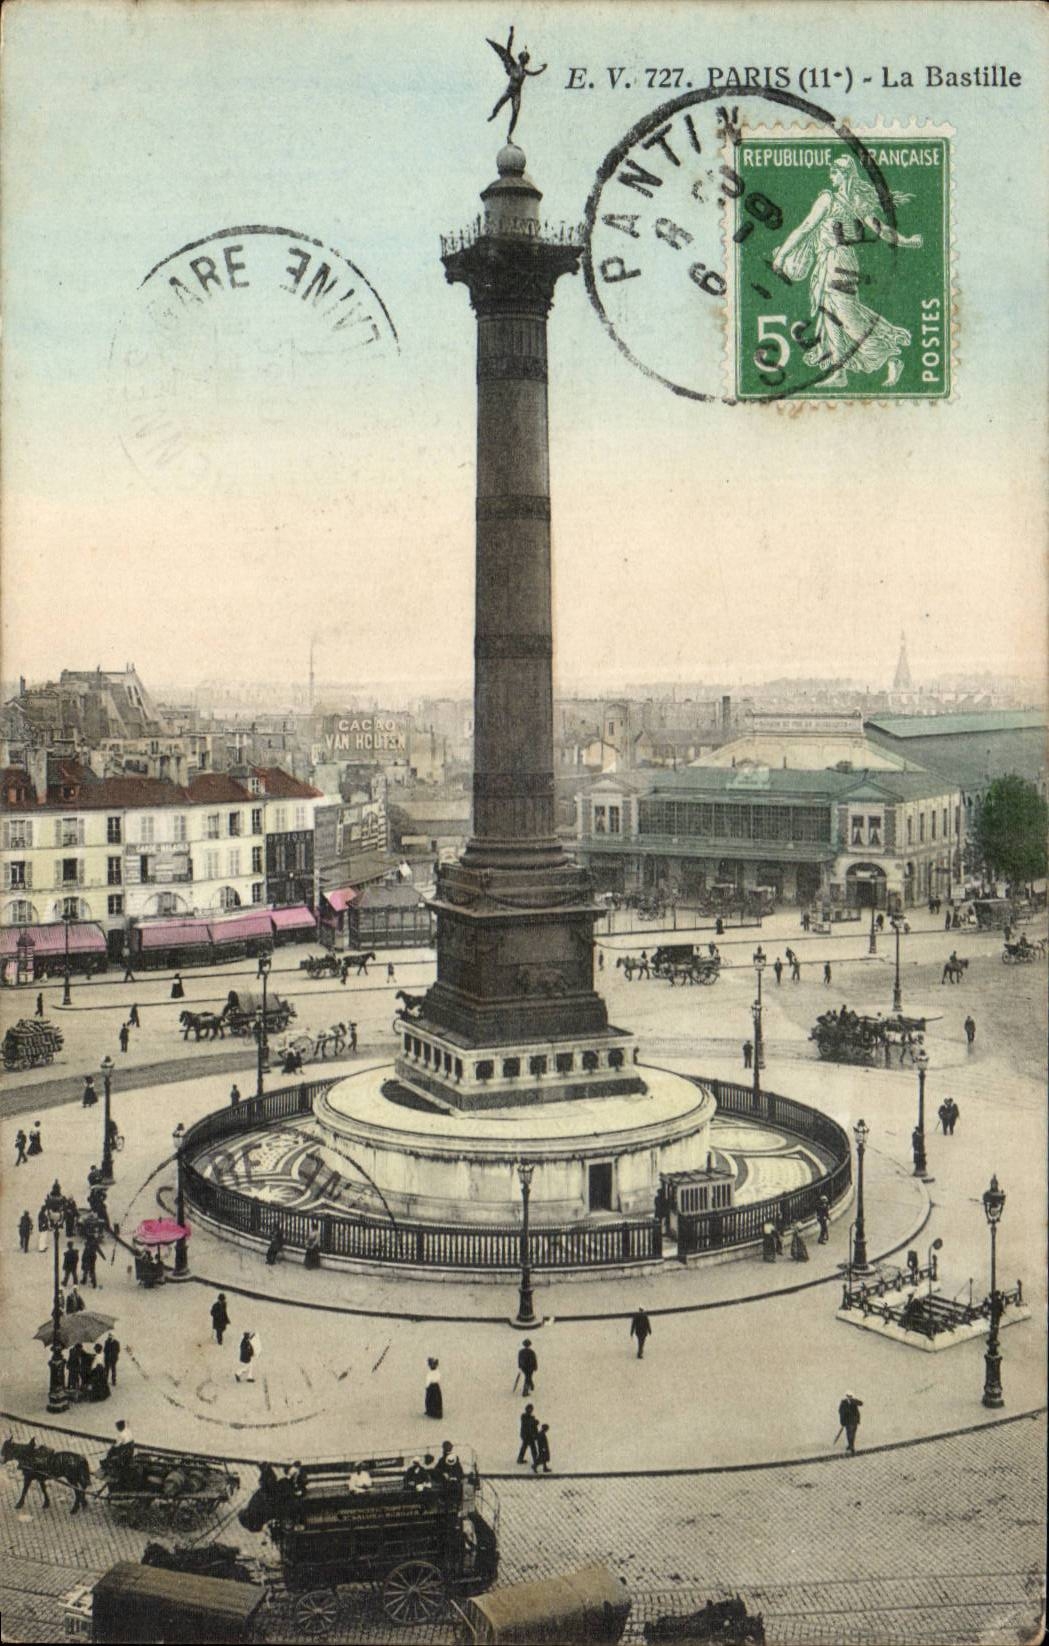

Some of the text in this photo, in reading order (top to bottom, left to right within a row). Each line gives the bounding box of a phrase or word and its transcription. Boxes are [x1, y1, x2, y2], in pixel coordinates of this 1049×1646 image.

[861, 148, 940, 168] RANÇAISE
[922, 298, 941, 383] POSTES
[338, 719, 397, 732] CACAO
[325, 732, 406, 751] VAN HOUTEN
